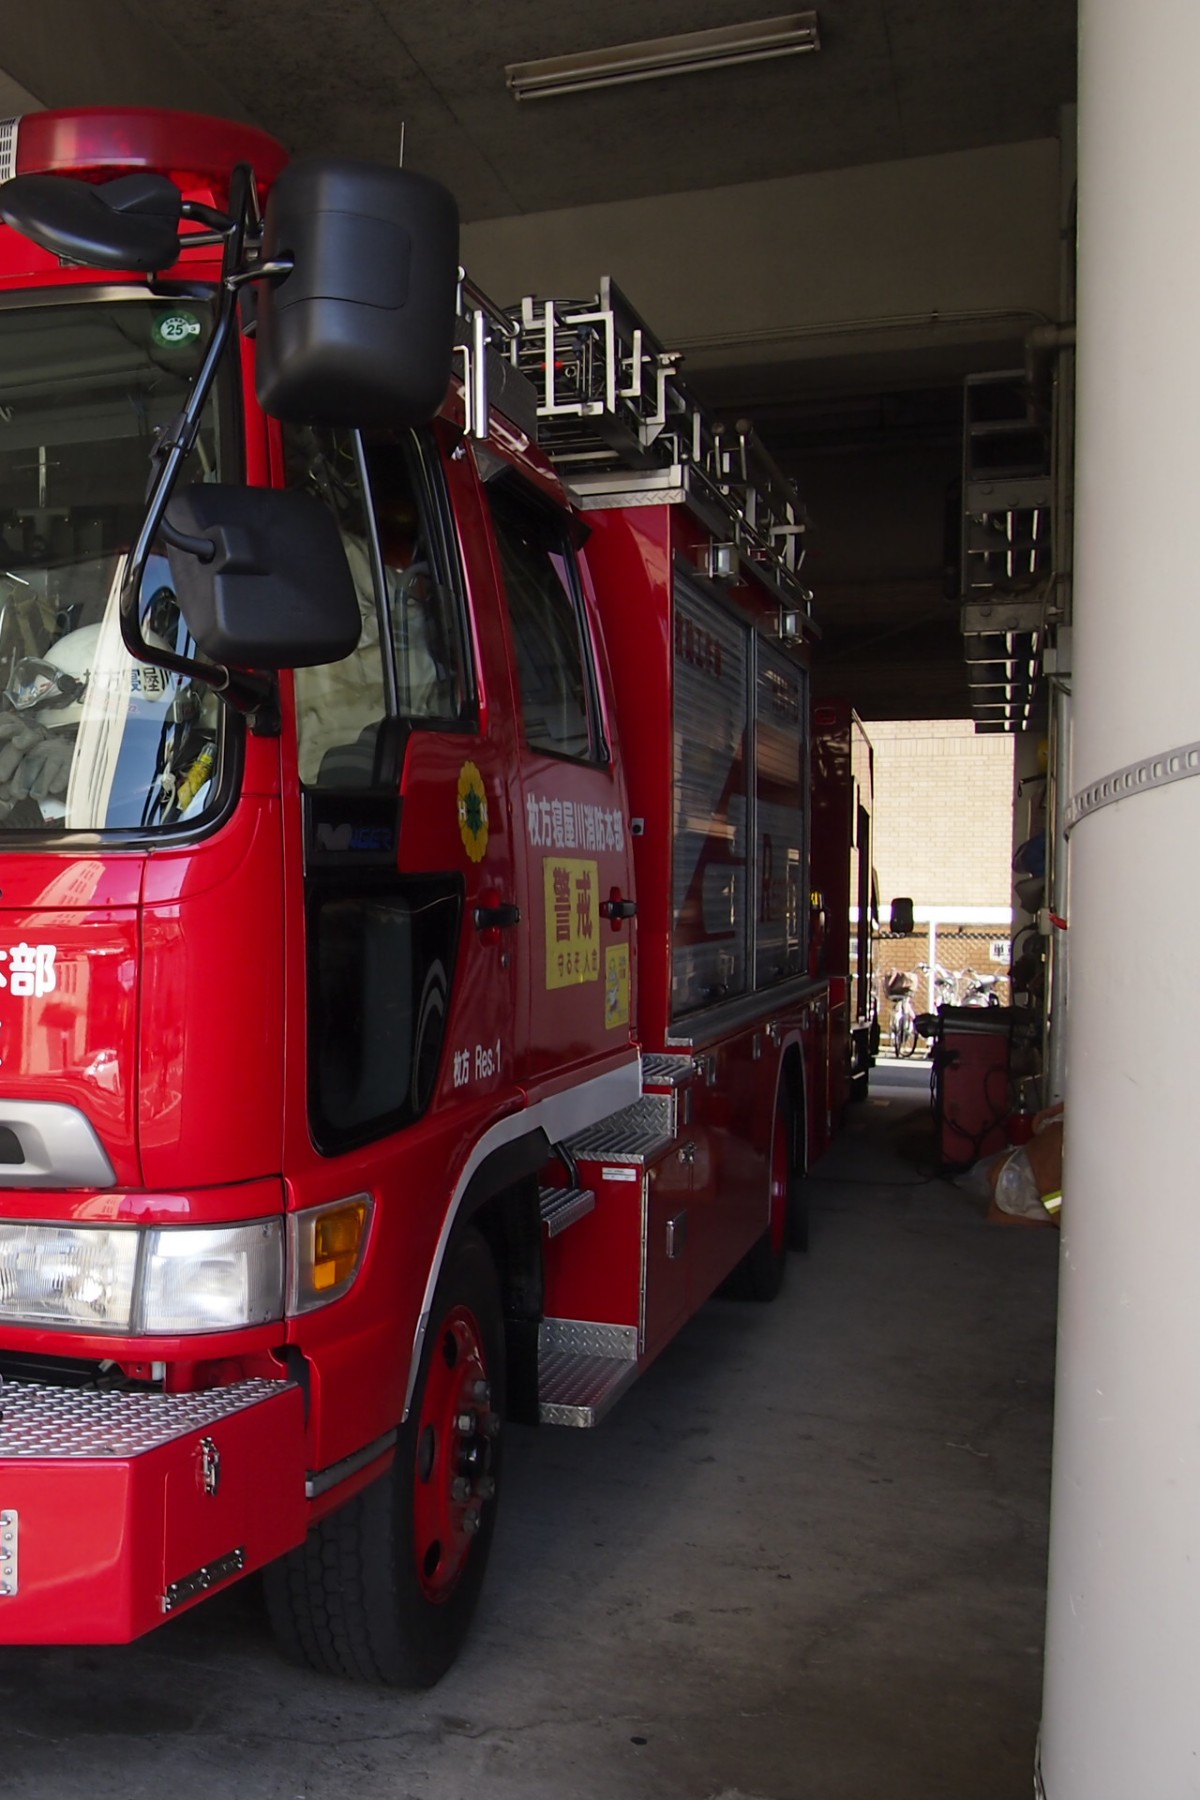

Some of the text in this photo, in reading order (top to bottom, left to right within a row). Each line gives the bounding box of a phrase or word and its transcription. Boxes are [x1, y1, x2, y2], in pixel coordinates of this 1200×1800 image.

[527, 793, 624, 853] 枚方寝屋川消防本部
[553, 866, 593, 943] 警戒
[454, 1048, 470, 1088] 枚方
